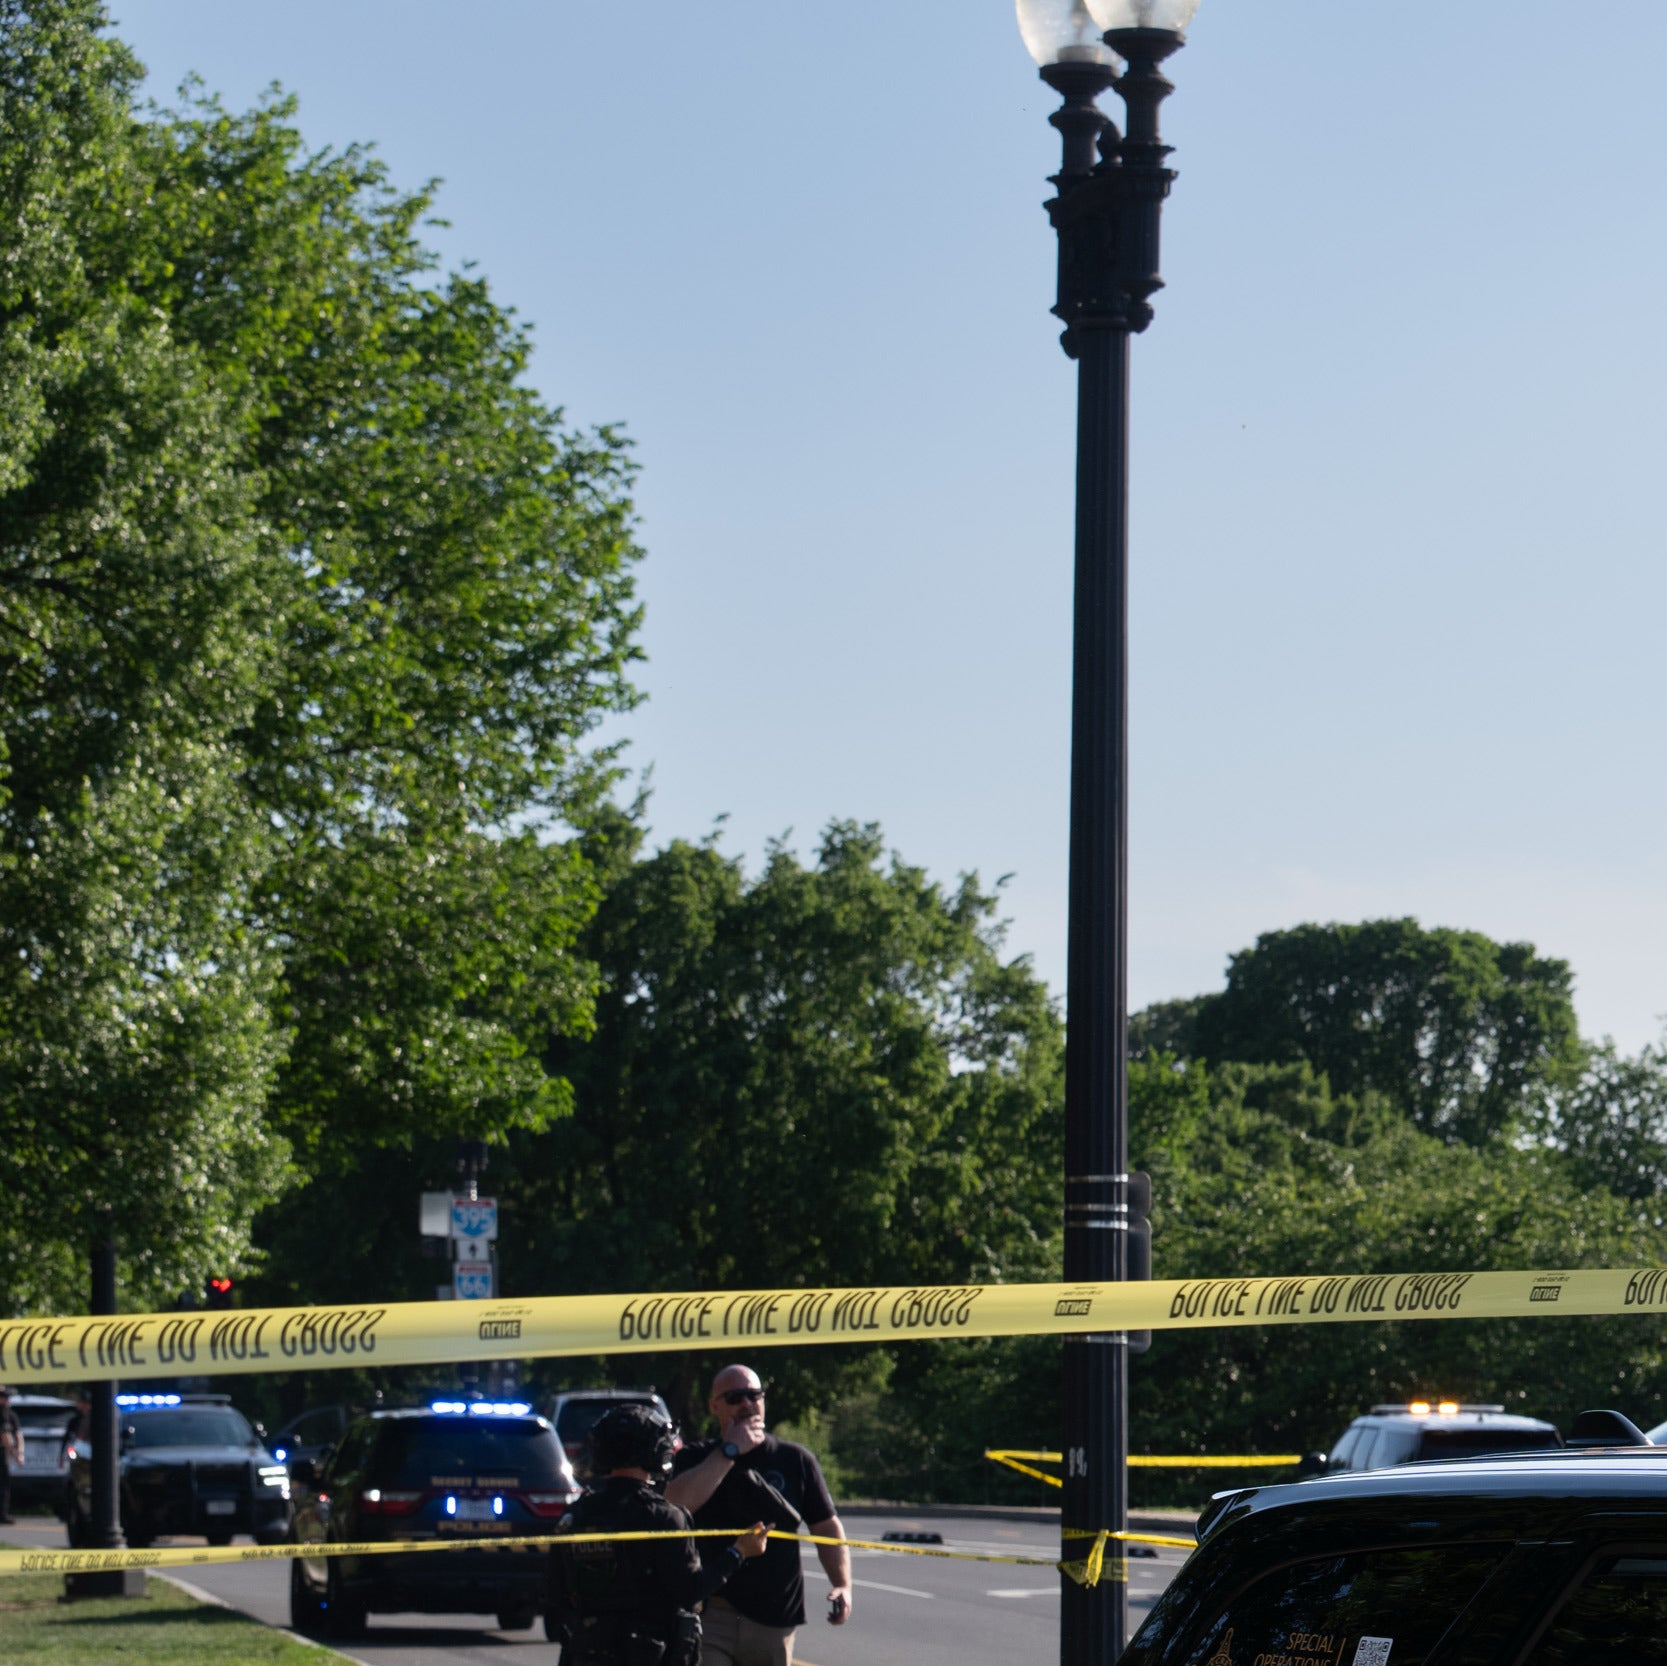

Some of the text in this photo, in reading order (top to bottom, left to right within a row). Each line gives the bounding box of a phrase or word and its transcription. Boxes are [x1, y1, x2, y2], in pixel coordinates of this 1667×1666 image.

[455, 1207, 494, 1230] 395
[461, 1274, 489, 1296] 66
[437, 1521, 512, 1533] POLICE
[1286, 1632, 1334, 1653] SPECIAL
